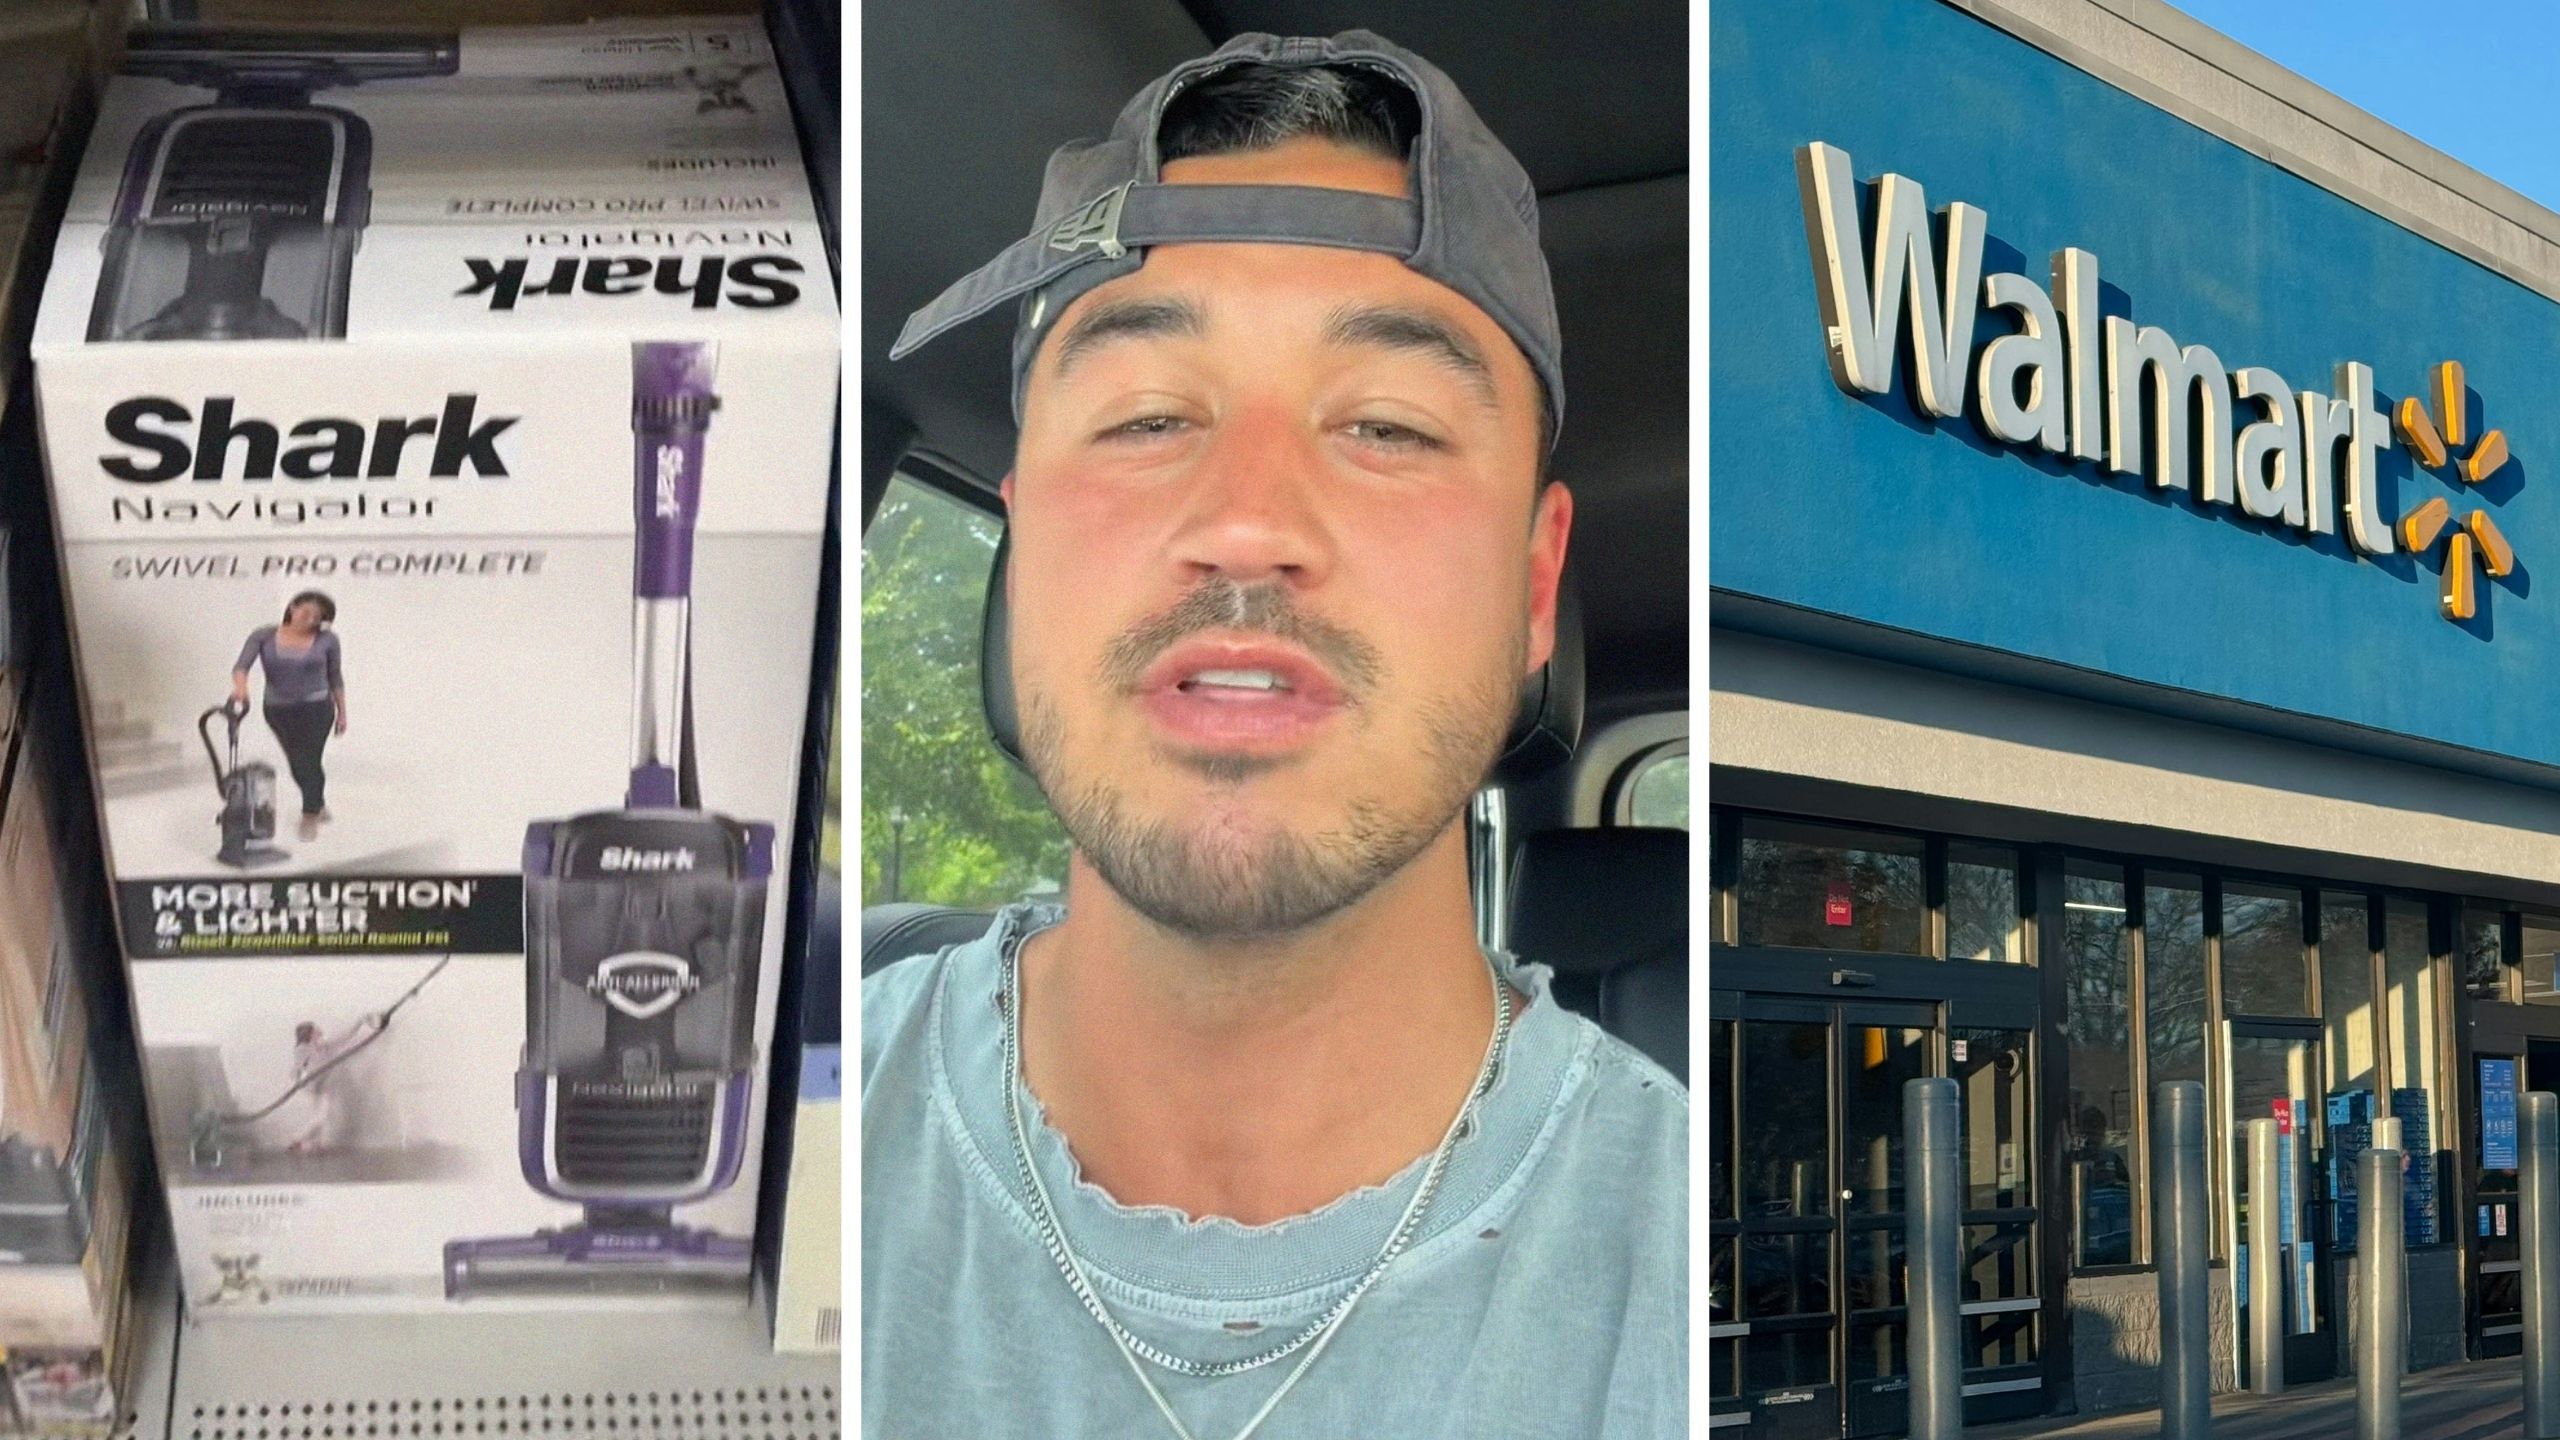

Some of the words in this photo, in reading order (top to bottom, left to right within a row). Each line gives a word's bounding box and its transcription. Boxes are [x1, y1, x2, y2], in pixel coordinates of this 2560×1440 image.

[444, 198, 597, 214] COMPLETE
[604, 197, 666, 213] PRO
[682, 197, 780, 213] SWIVEL
[525, 230, 792, 248] Navigator
[452, 257, 805, 312] Shark
[1795, 140, 2396, 556] Walmart
[98, 392, 522, 484] Shark
[112, 494, 438, 526] Navigator
[112, 554, 250, 581] SWIVEL
[261, 554, 337, 578] PRO
[350, 551, 548, 577] COMPLETE
[600, 846, 696, 871] Shark
[152, 882, 275, 912] MORE
[1830, 903, 1847, 914] Enter
[154, 910, 182, 936] &
[195, 907, 369, 935] LIGHTER
